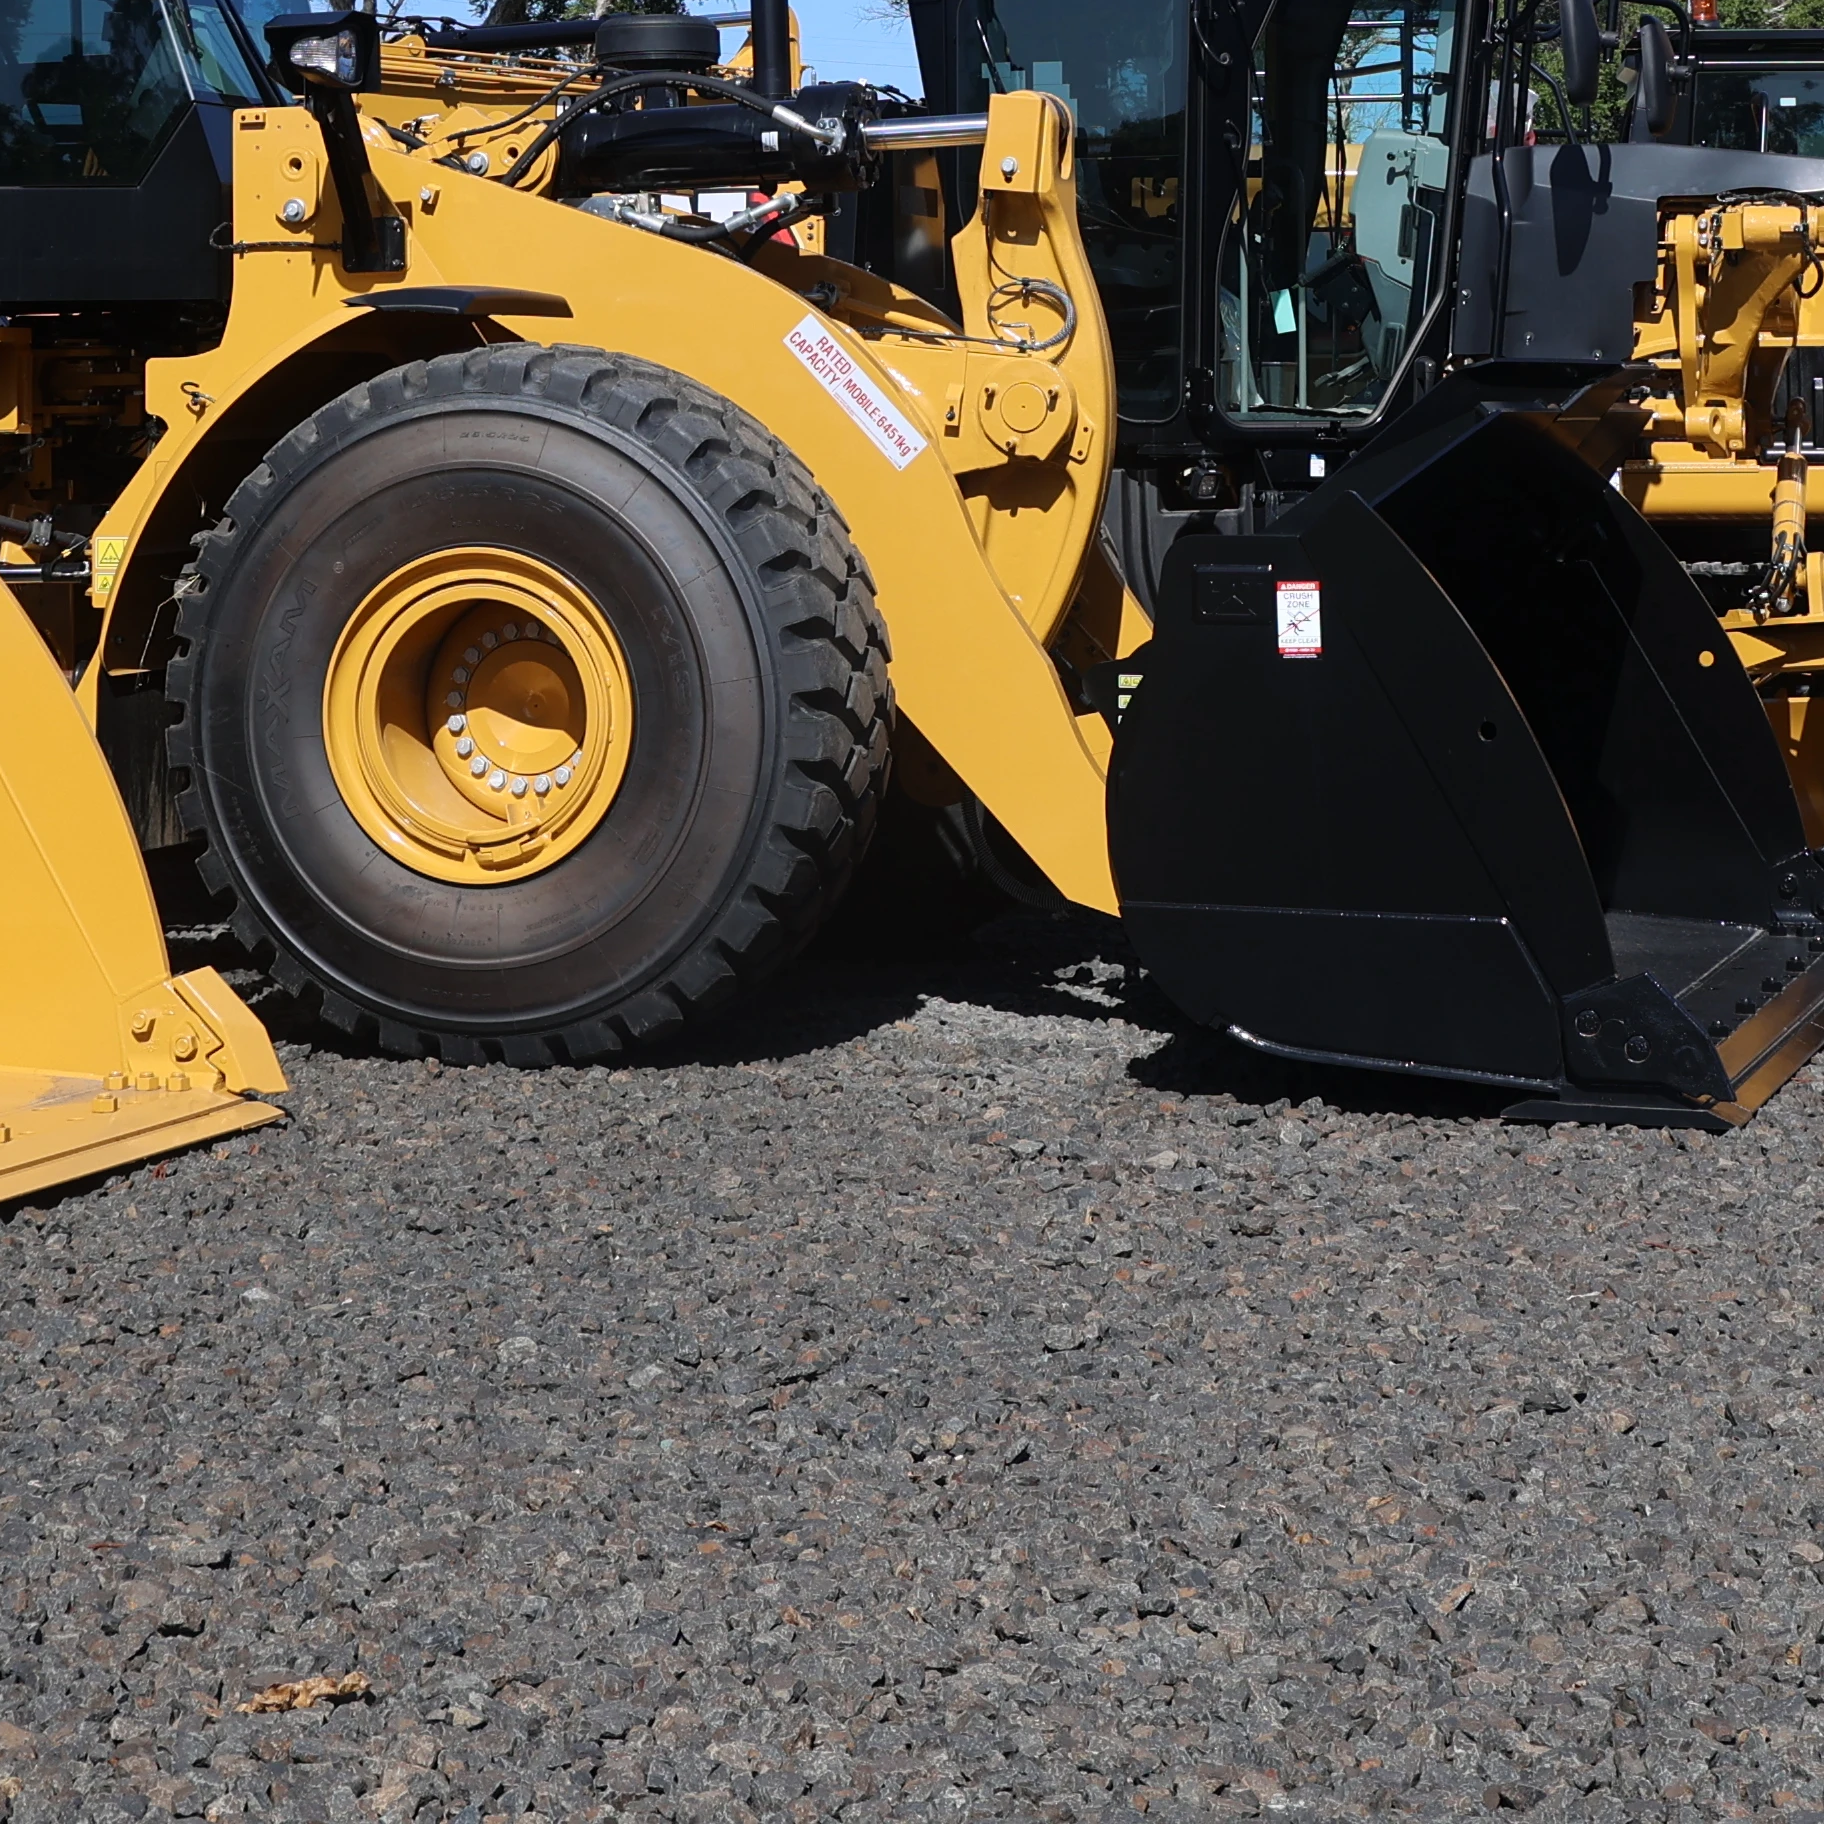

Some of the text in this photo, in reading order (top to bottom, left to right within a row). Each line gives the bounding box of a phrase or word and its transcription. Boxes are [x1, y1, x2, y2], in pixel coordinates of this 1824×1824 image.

[789, 331, 841, 386] CAPACITY
[816, 335, 852, 375] RATED
[1283, 592, 1314, 600] CRUSH
[1287, 600, 1310, 608] ZONE
